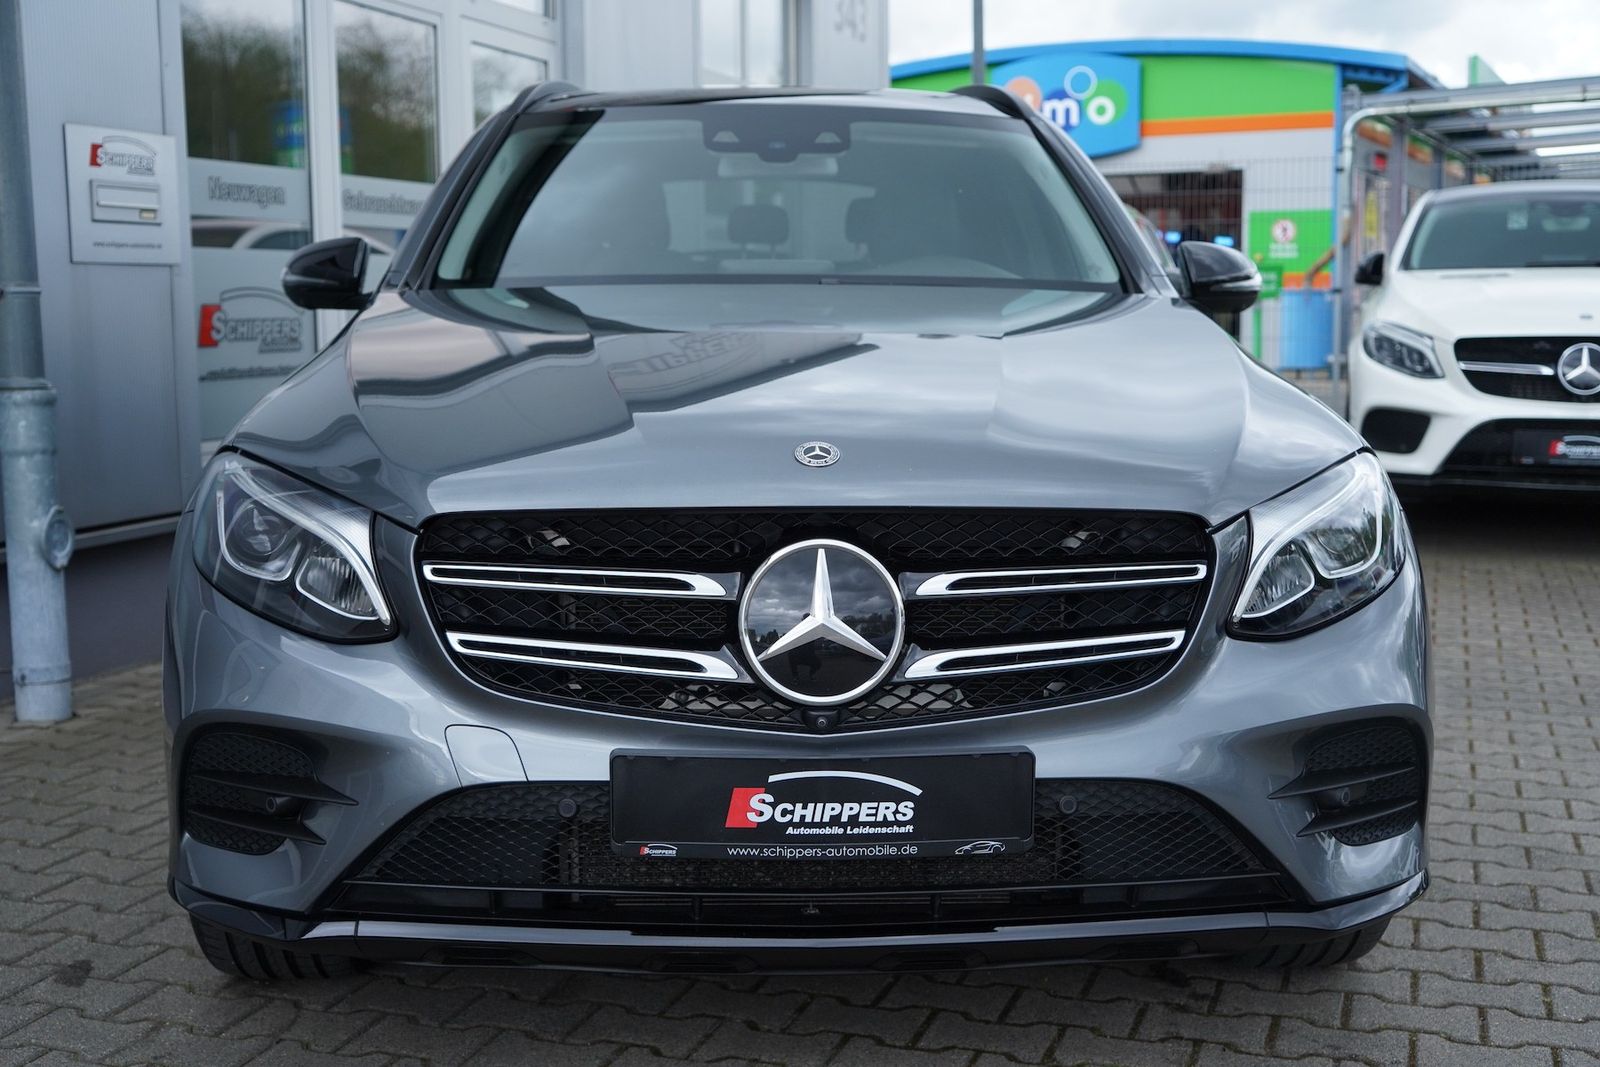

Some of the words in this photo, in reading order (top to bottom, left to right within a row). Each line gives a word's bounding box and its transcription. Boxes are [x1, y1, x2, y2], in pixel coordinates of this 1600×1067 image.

[207, 176, 286, 208] Neuwagen
[211, 310, 302, 343] SCHIPPERS
[747, 793, 915, 823] SCHIPPERS
[785, 825, 844, 835] Automobile
[846, 824, 915, 834] Leidenschaft
[644, 847, 677, 855] SCHIPPERS
[727, 844, 918, 859] www.schippers-automobile.de
